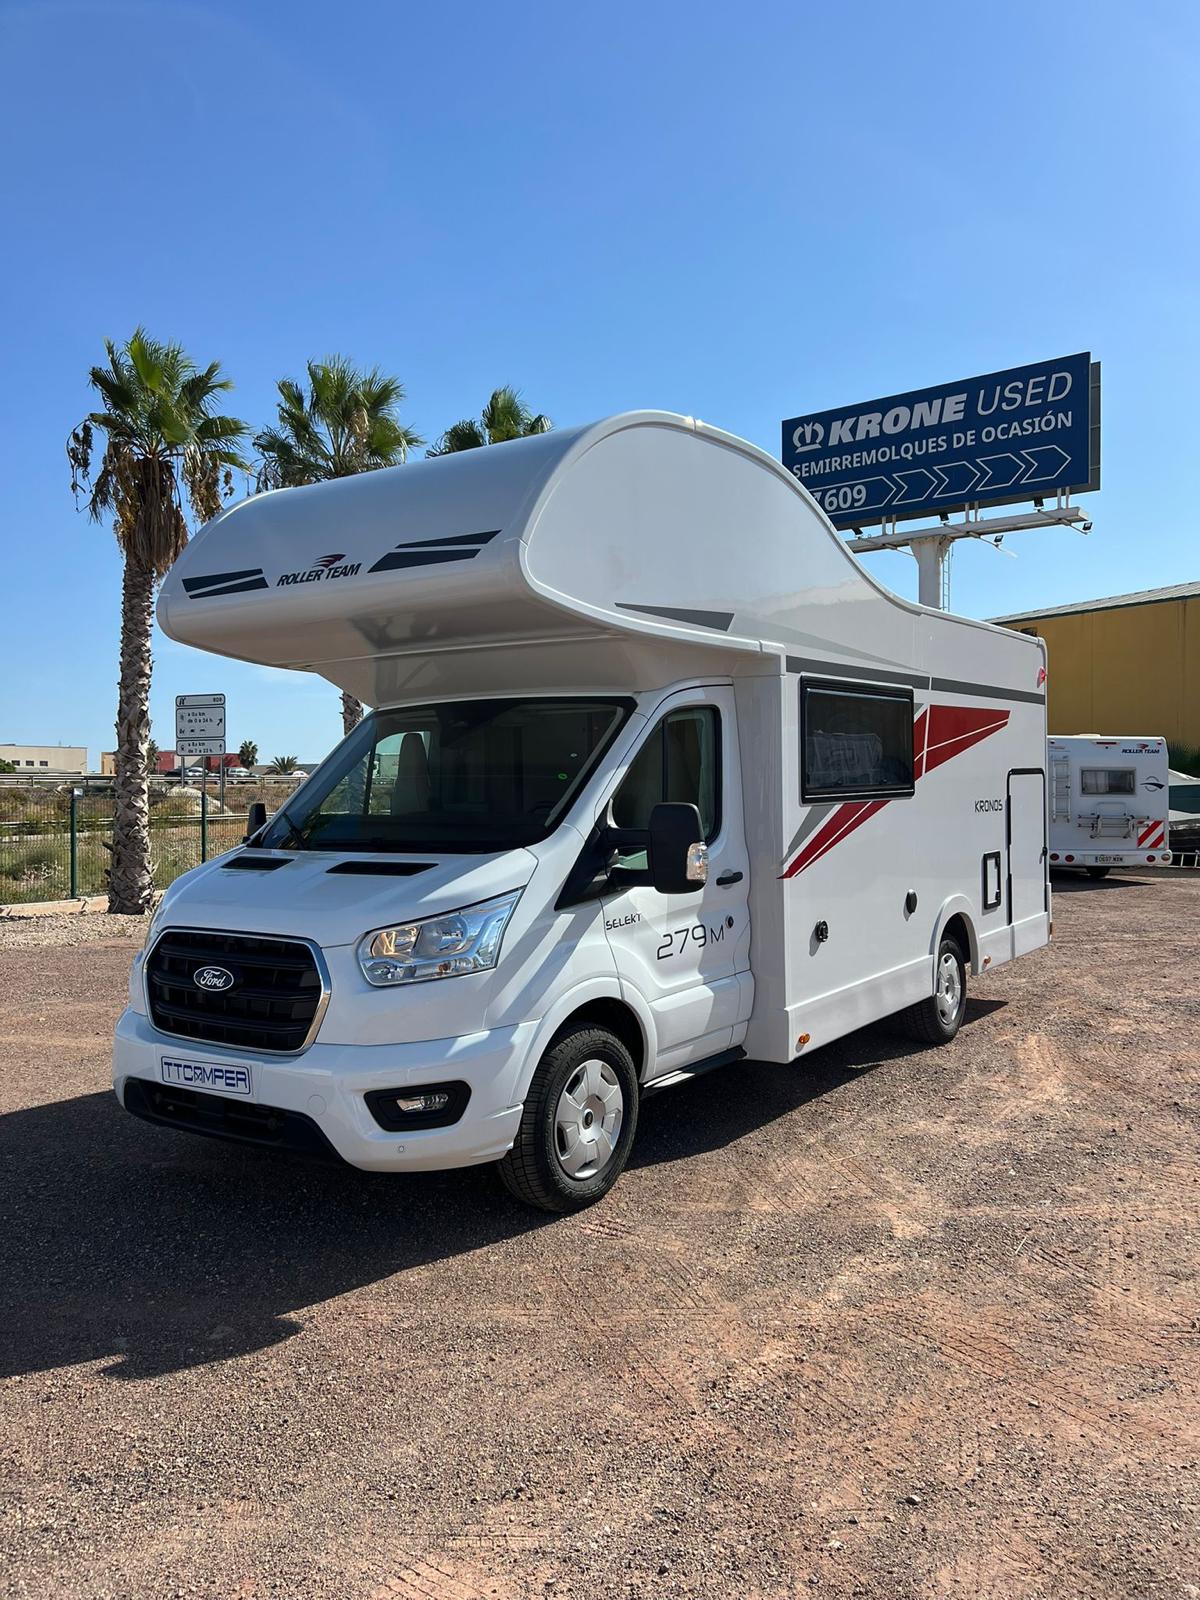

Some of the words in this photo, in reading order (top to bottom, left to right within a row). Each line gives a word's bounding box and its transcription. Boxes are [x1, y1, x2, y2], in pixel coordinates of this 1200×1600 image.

[828, 394, 967, 446] KRONE
[977, 372, 1073, 415] USED
[792, 436, 947, 478] SEMIRREMOLQUES
[953, 430, 976, 449] DE
[981, 410, 1073, 443] OCASIÓN
[276, 569, 325, 586] ROLLER
[326, 563, 362, 579] TEAM
[974, 799, 1003, 812] KRONOS
[200, 969, 226, 987] Ford
